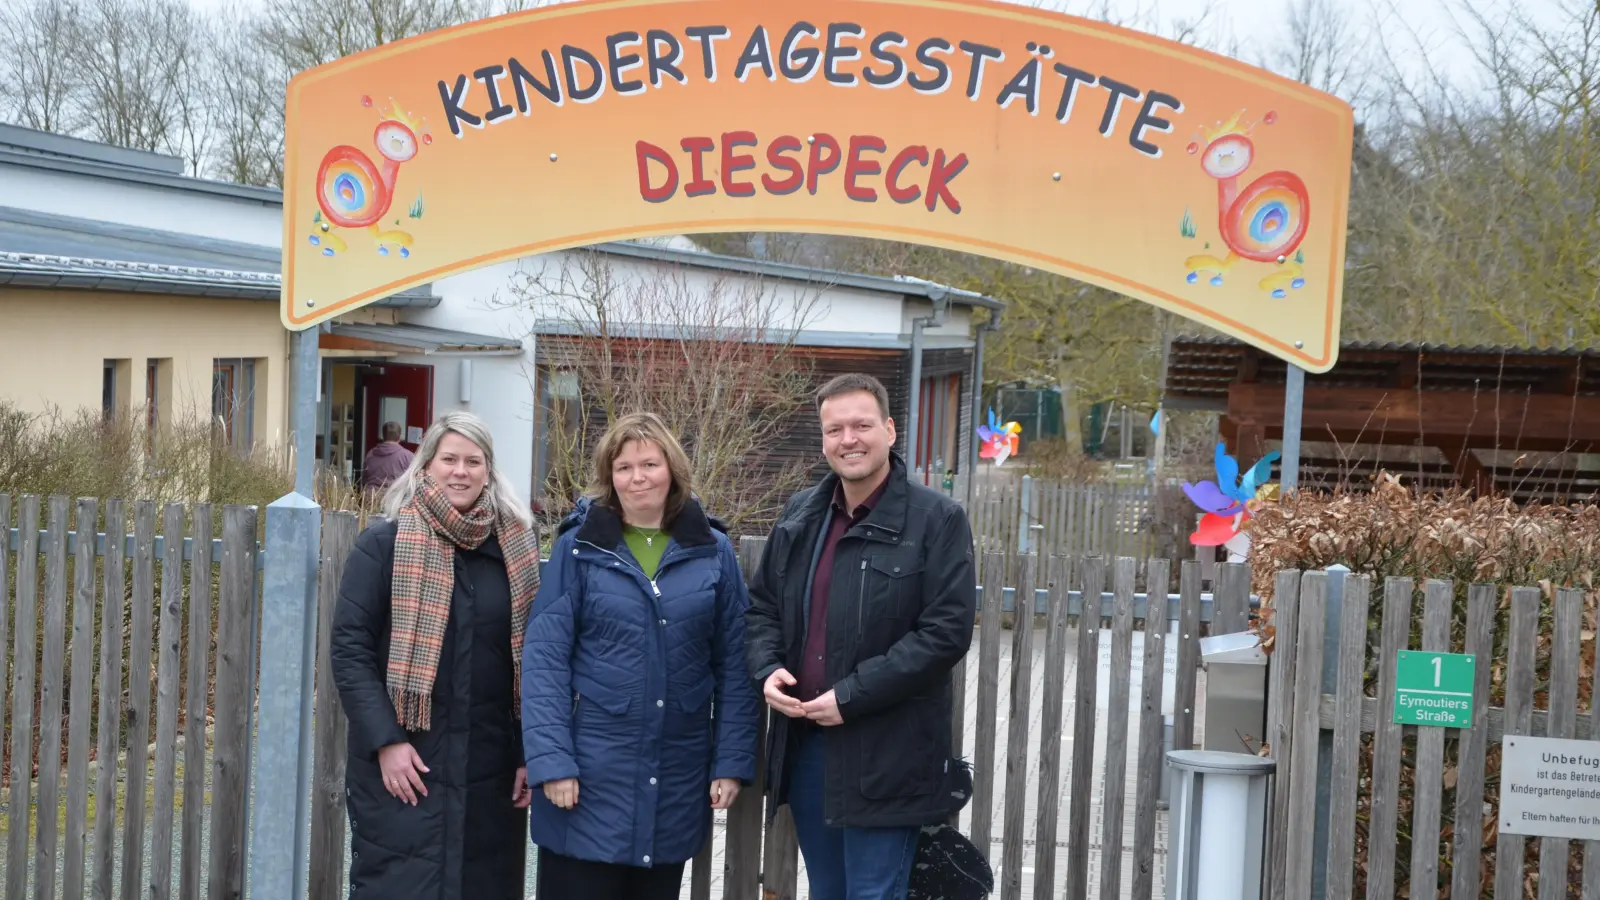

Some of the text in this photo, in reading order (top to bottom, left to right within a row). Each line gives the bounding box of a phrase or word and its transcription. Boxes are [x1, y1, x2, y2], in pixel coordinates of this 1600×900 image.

[438, 21, 1185, 158] KINDERTAGESSTÄTTE
[636, 131, 969, 214] DIESPECK
[1431, 656, 1442, 688] 1
[1399, 694, 1469, 710] Eymoutiers
[1415, 709, 1456, 722] Straße
[1537, 769, 1548, 780] ist
[1551, 770, 1567, 781] das
[1521, 811, 1547, 821] Eltern
[1549, 813, 1577, 824] haften
[1579, 815, 1590, 825] für
